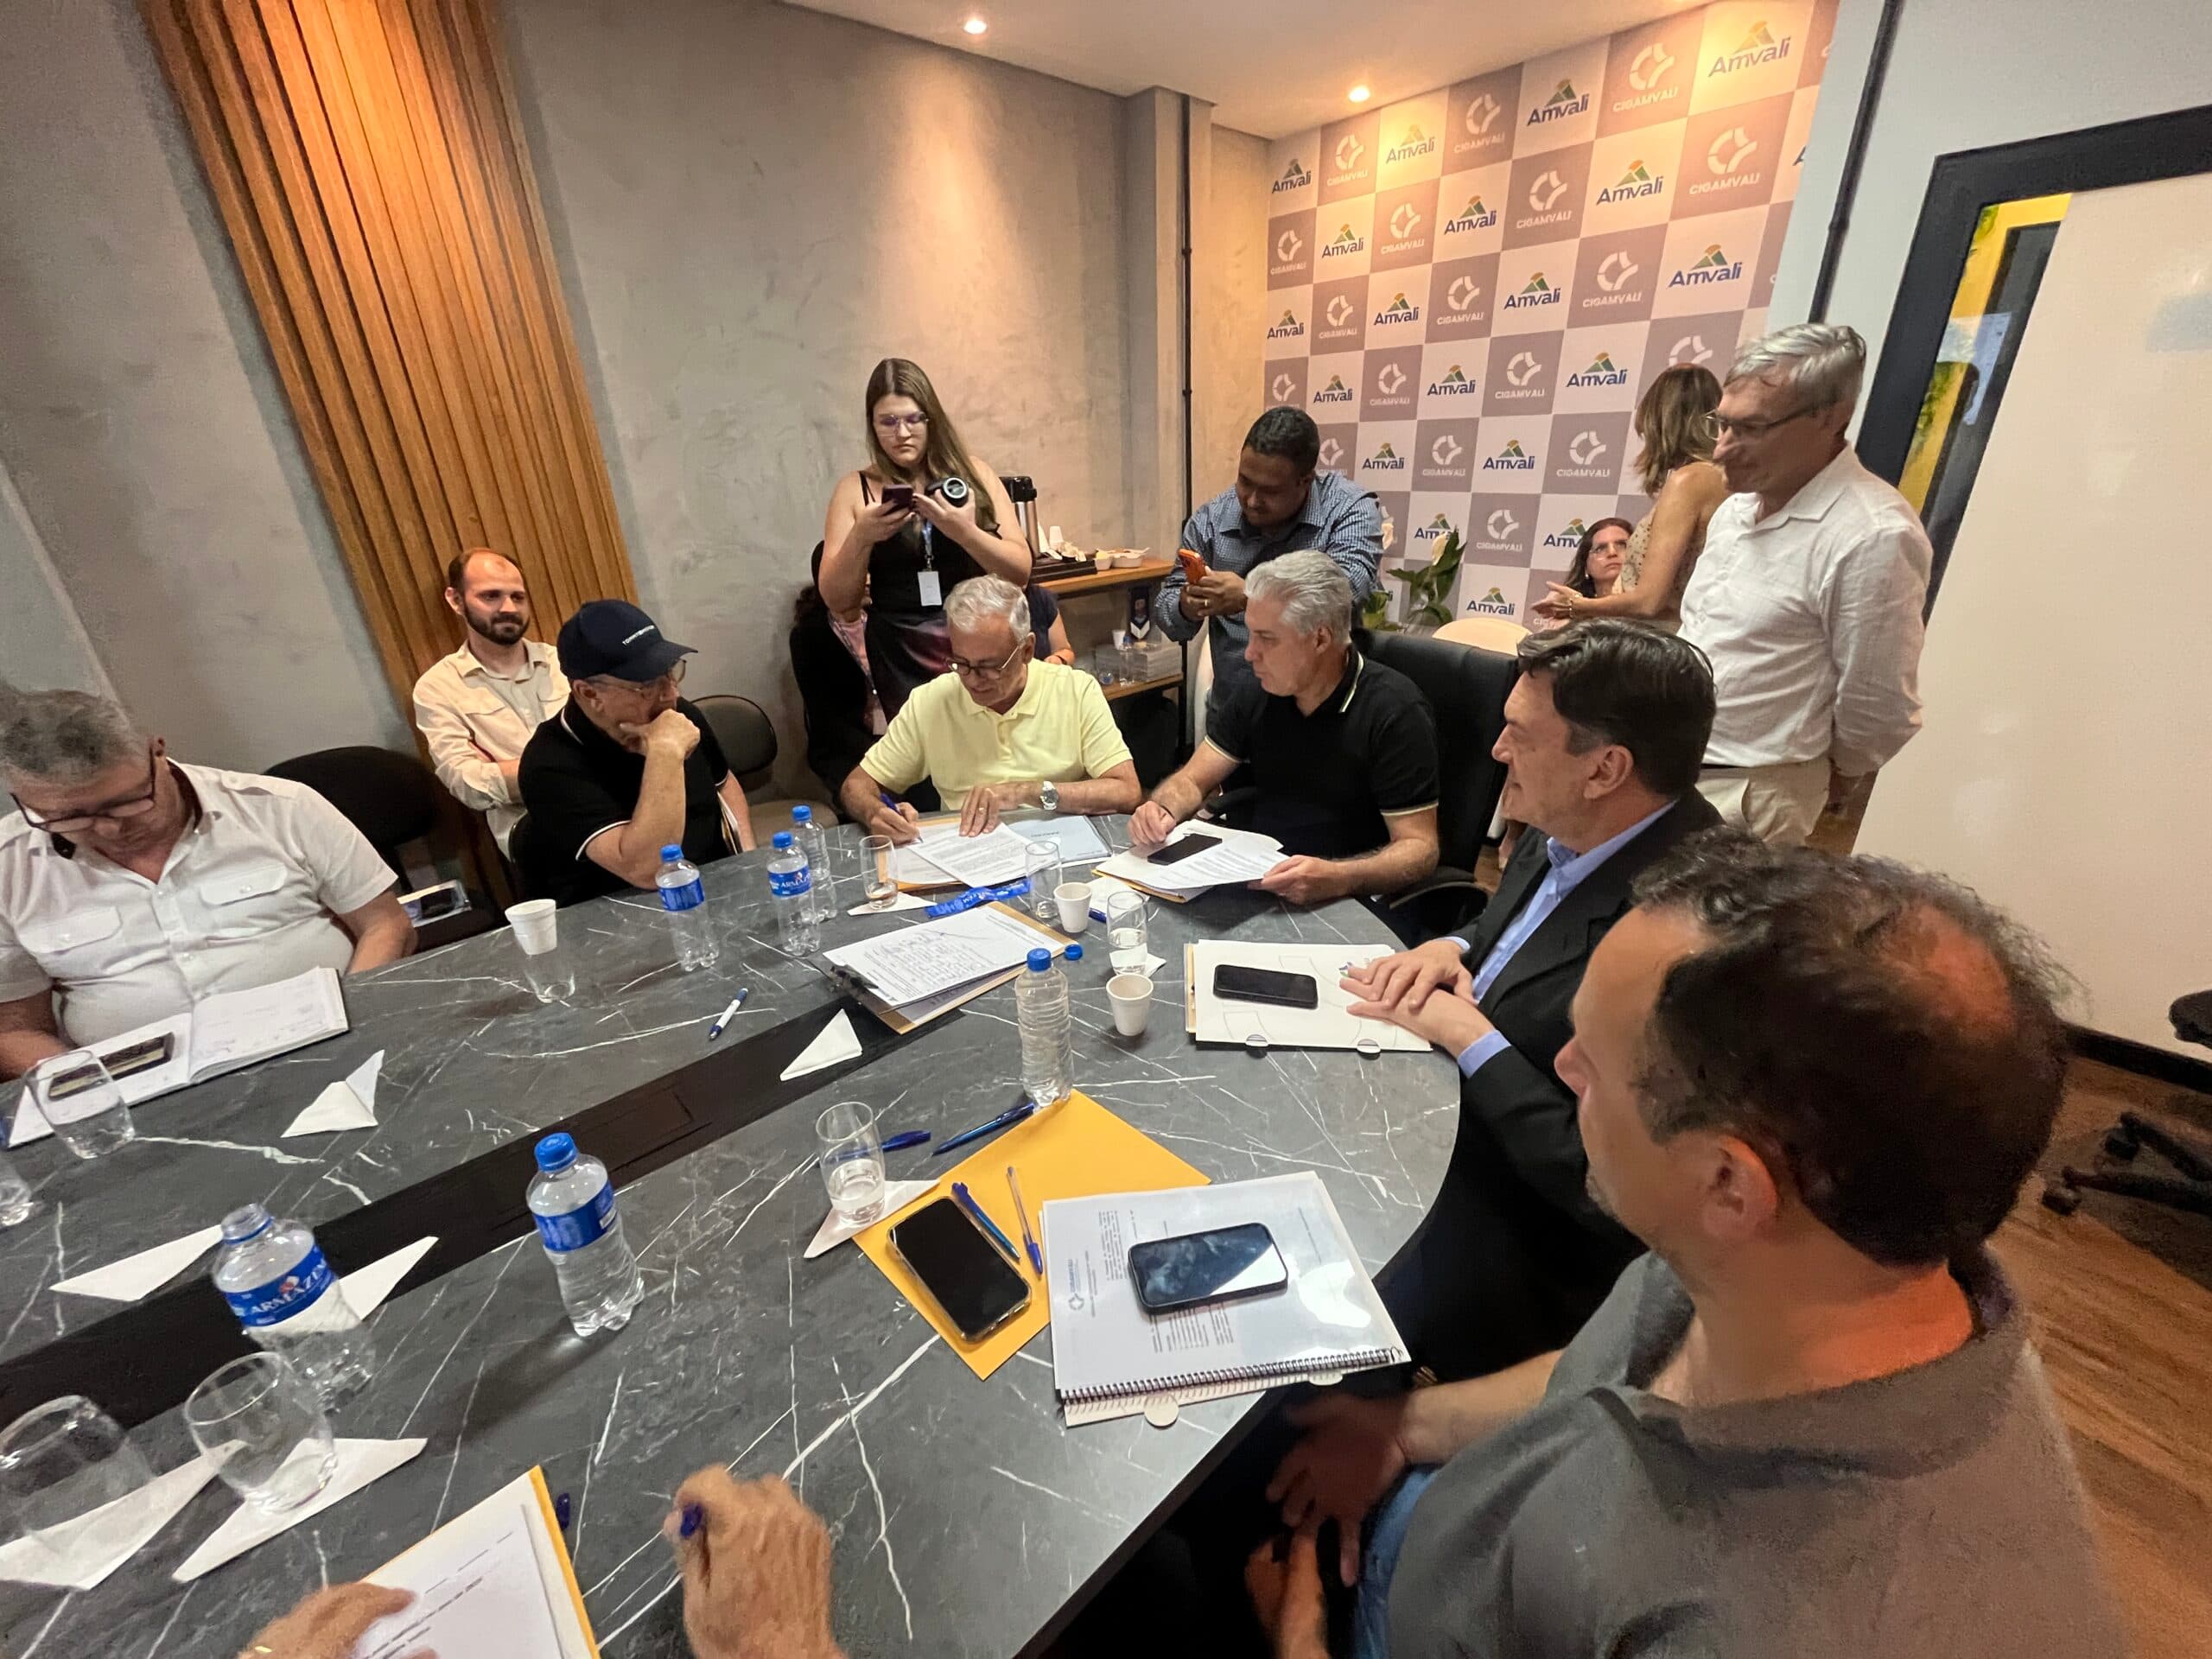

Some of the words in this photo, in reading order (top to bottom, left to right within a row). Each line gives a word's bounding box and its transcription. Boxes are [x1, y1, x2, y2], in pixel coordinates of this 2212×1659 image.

[1707, 37, 1791, 78] Amvali
[1613, 87, 1679, 112] CIGAMVALI
[1527, 93, 1589, 126] Amvali
[1385, 137, 1435, 164] Amvali
[1454, 132, 1505, 154] CIGAMVALI
[1272, 171, 1311, 194] Amvali
[1327, 170, 1368, 186] CIGAMVALI
[1689, 173, 1759, 195] CIGAMVALI
[1596, 176, 1663, 206] Amvali
[1444, 210, 1497, 235] Amvali
[1516, 211, 1572, 229] CIGAMVALI
[1322, 238, 1363, 258] Amvali
[1381, 238, 1424, 255] CIGAMVALI
[1669, 262, 1743, 288] Amvali
[1503, 288, 1561, 309] Amvali
[1583, 292, 1642, 308] CIGAMVALI
[1374, 307, 1419, 326] Amvali
[1437, 312, 1484, 325] CIGAMVALI
[1267, 322, 1304, 339] Amvali
[1319, 328, 1357, 340] CIGAMVALI
[1567, 369, 1628, 388] Amvali
[1313, 389, 1353, 404] Amvali
[1427, 379, 1476, 397] Amvali
[1495, 389, 1545, 399] CIGAMVALI
[1370, 397, 1410, 406] CIGAMVALI
[1363, 457, 1404, 470] Amvali
[1483, 455, 1535, 470] Amvali
[1556, 469, 1611, 478] CIGAMVALI
[1477, 542, 1522, 552] CIGAMVALI
[1543, 534, 1582, 548] Amv
[1467, 601, 1515, 616] Amvali
